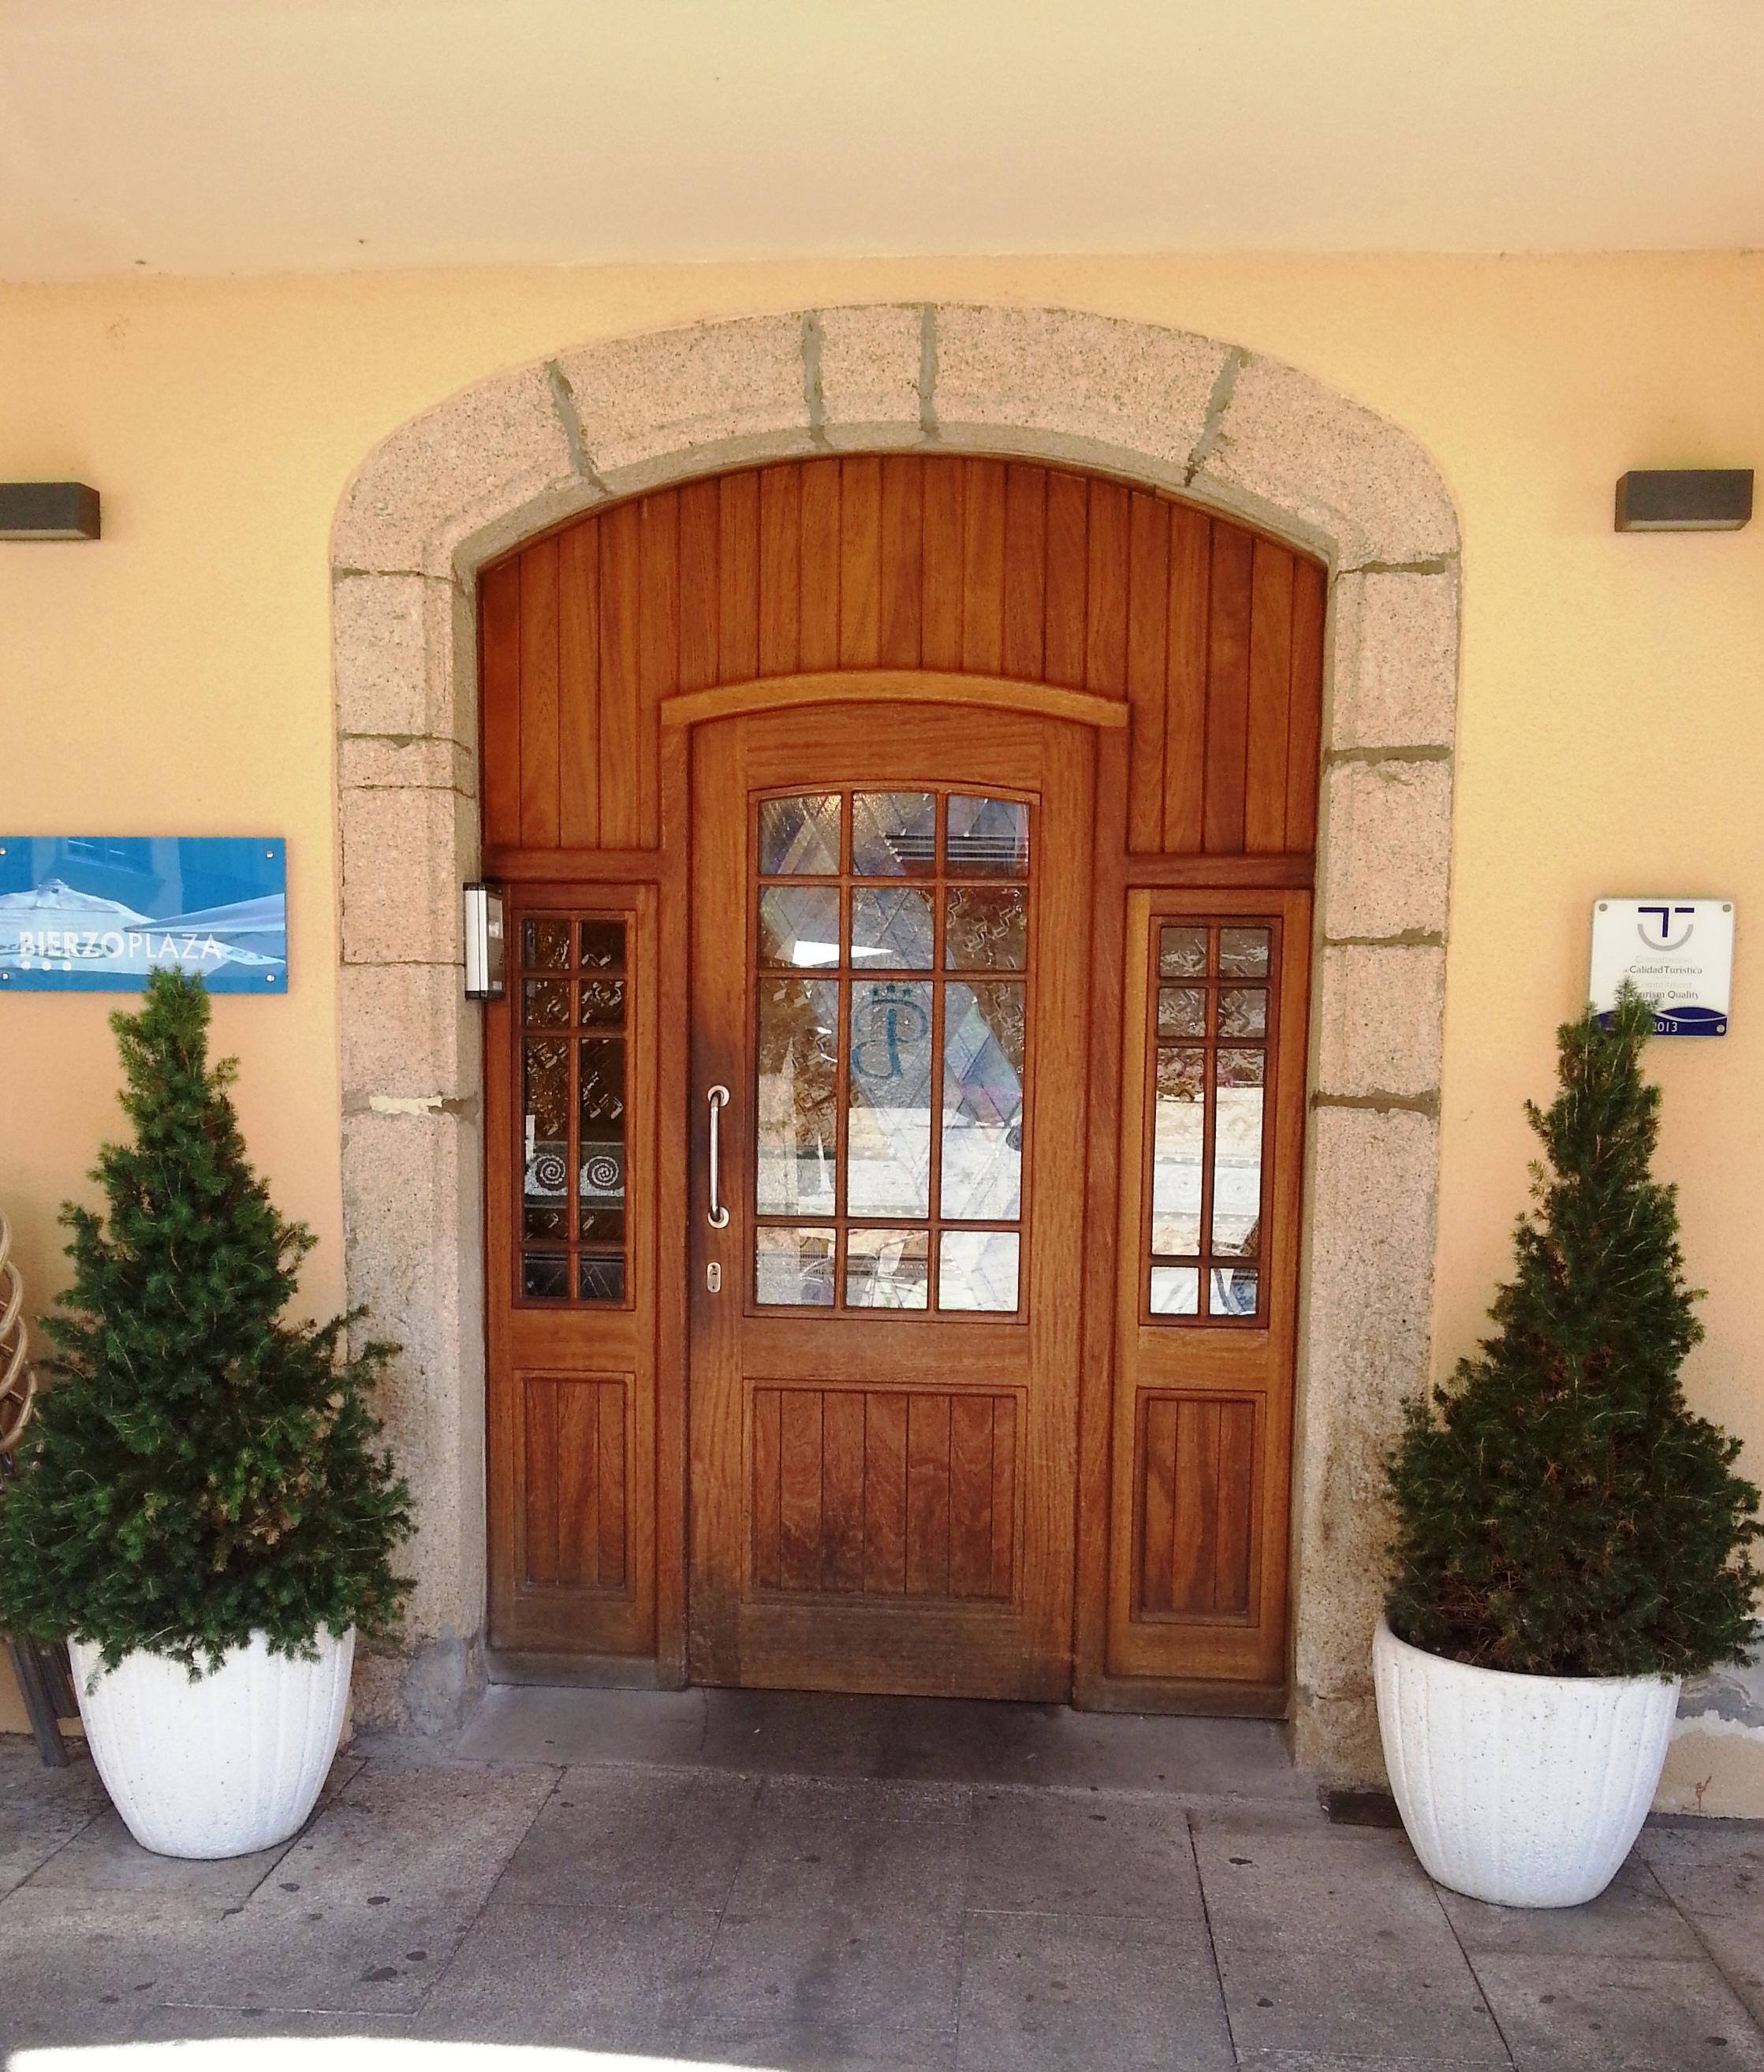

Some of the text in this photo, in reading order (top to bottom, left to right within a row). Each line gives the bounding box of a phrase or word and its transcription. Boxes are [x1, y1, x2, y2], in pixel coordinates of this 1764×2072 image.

[19, 930, 222, 960] BIERZOPLAZA
[1629, 965, 1663, 974] Calidad
[1667, 990, 1699, 1000] Quality
